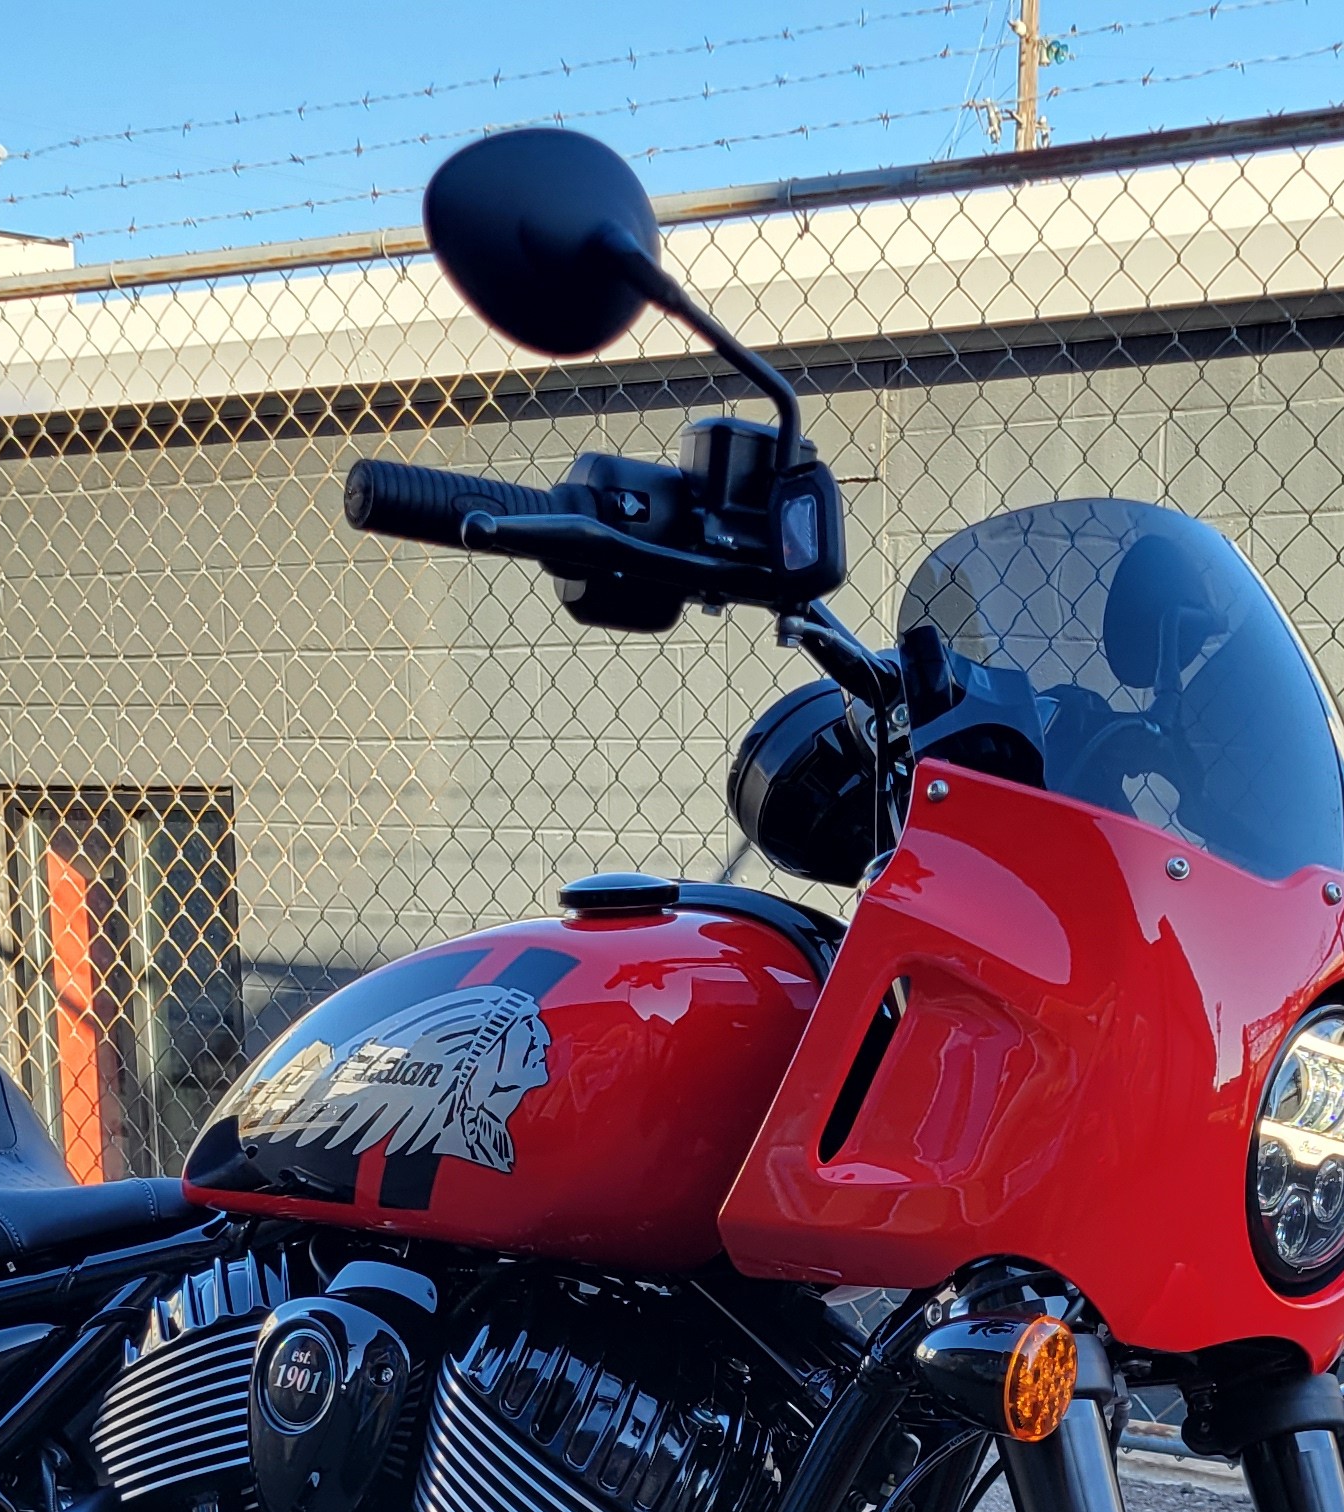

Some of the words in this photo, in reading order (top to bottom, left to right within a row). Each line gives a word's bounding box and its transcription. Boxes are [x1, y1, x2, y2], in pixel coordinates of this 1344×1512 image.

[330, 1037, 444, 1087] dian
[291, 1350, 311, 1365] est.
[273, 1363, 323, 1395] 1901
